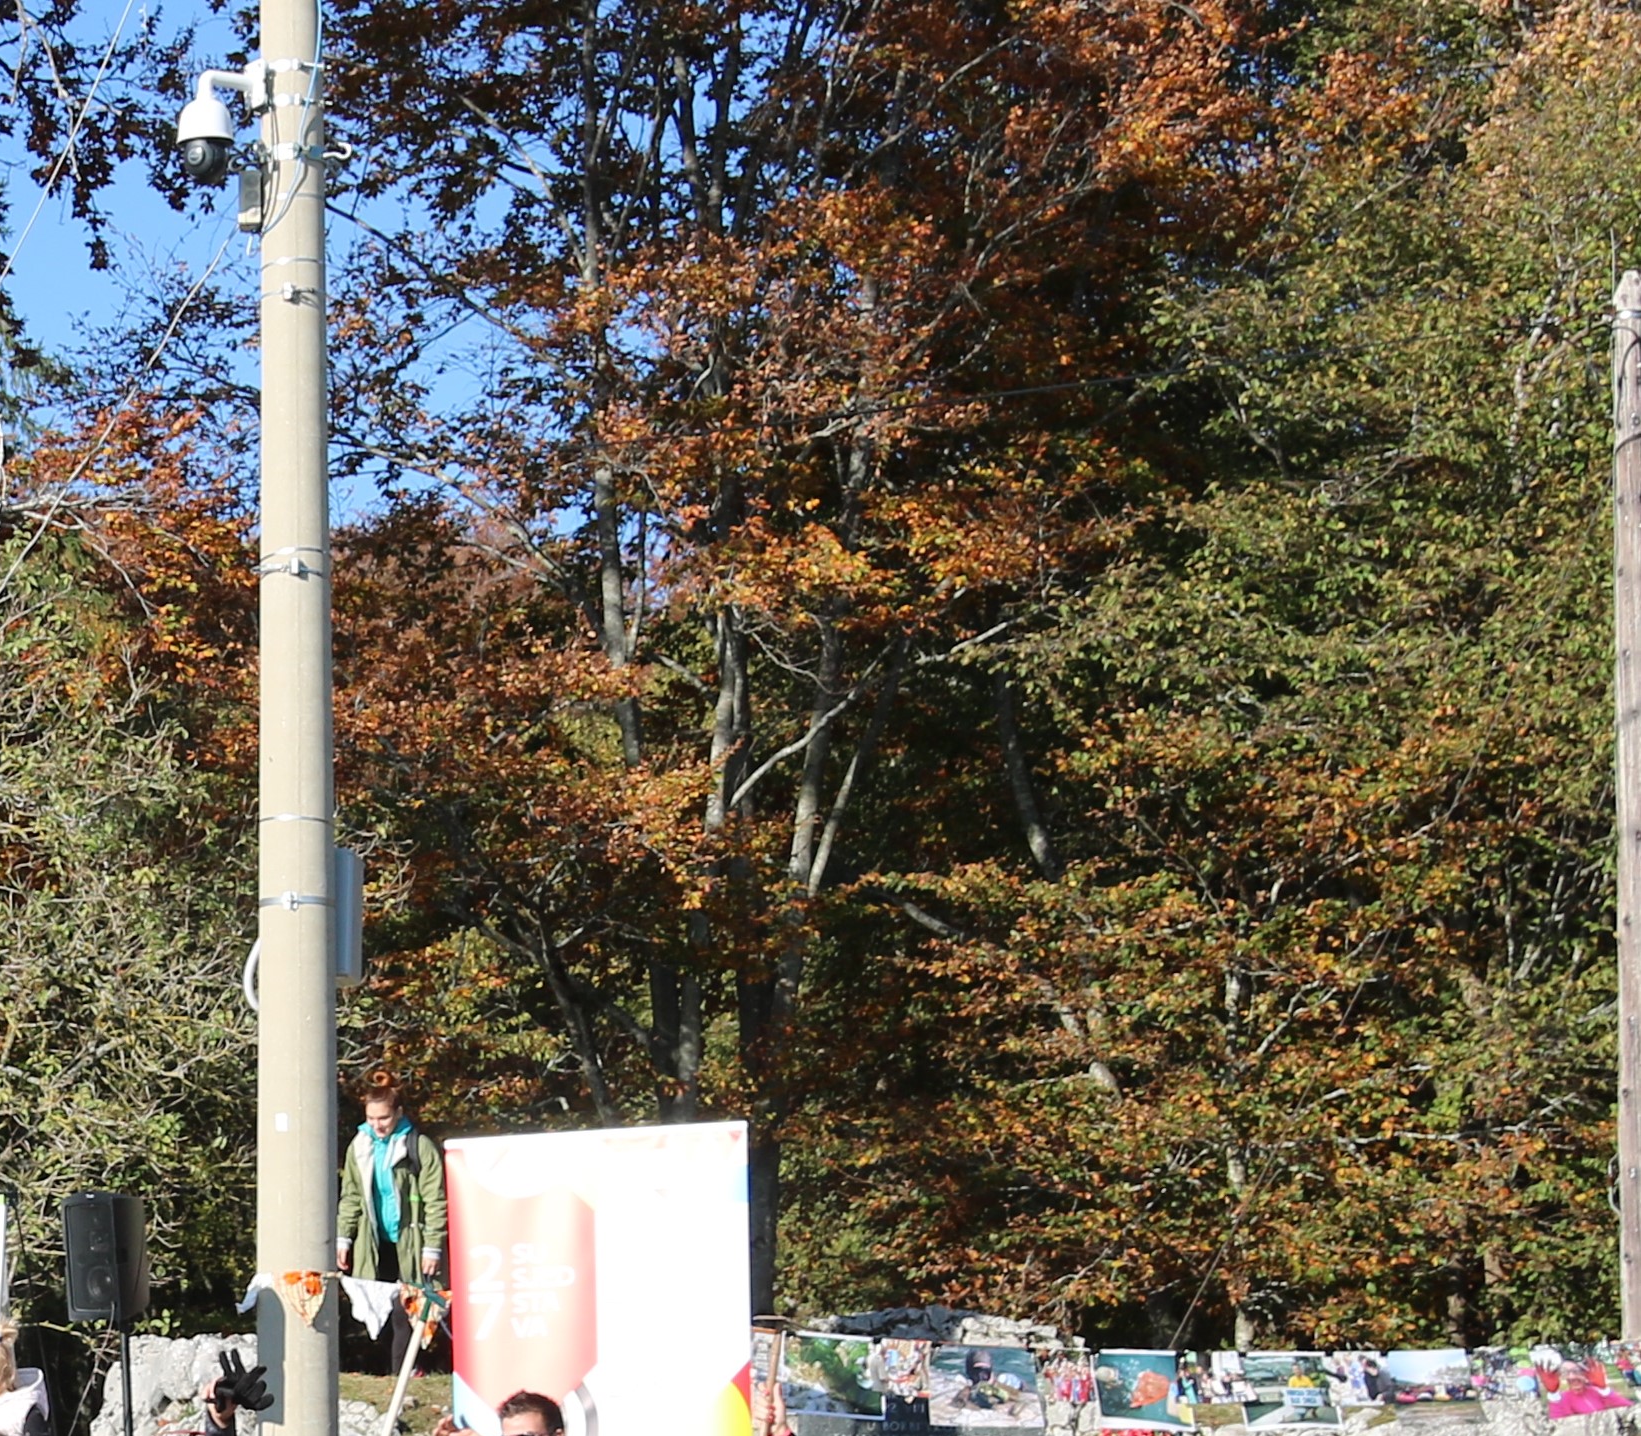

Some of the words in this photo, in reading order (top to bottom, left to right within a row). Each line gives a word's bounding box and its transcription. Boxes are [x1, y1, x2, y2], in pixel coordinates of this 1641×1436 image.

[468, 1244, 506, 1293] 2
[468, 1292, 506, 1342] 7
[510, 1315, 550, 1339] VA
